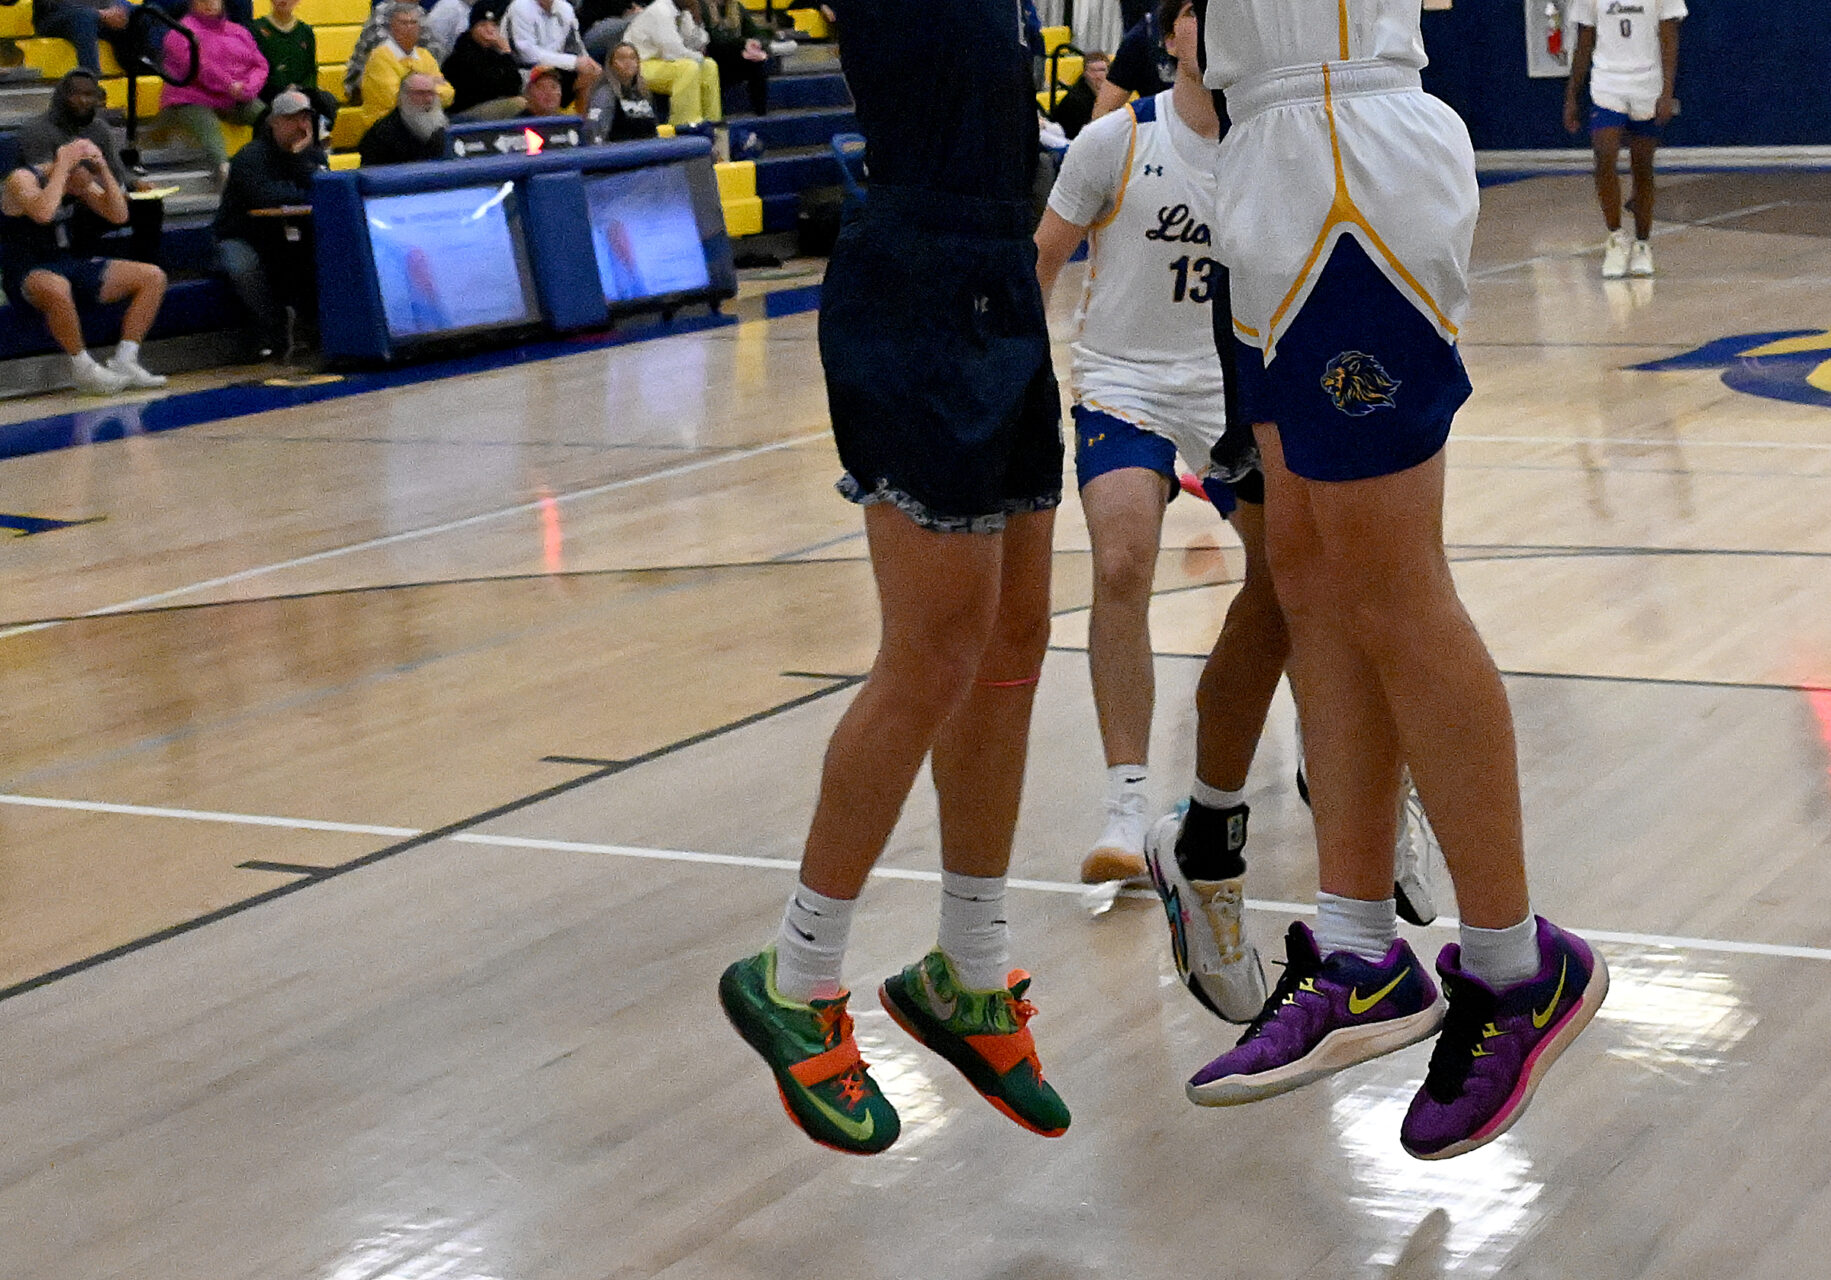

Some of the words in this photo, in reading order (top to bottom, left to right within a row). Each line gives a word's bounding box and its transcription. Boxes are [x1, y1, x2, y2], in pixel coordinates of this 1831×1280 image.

[1620, 18, 1632, 38] 0
[1145, 203, 1212, 247] Lio
[1169, 255, 1215, 303] 13
